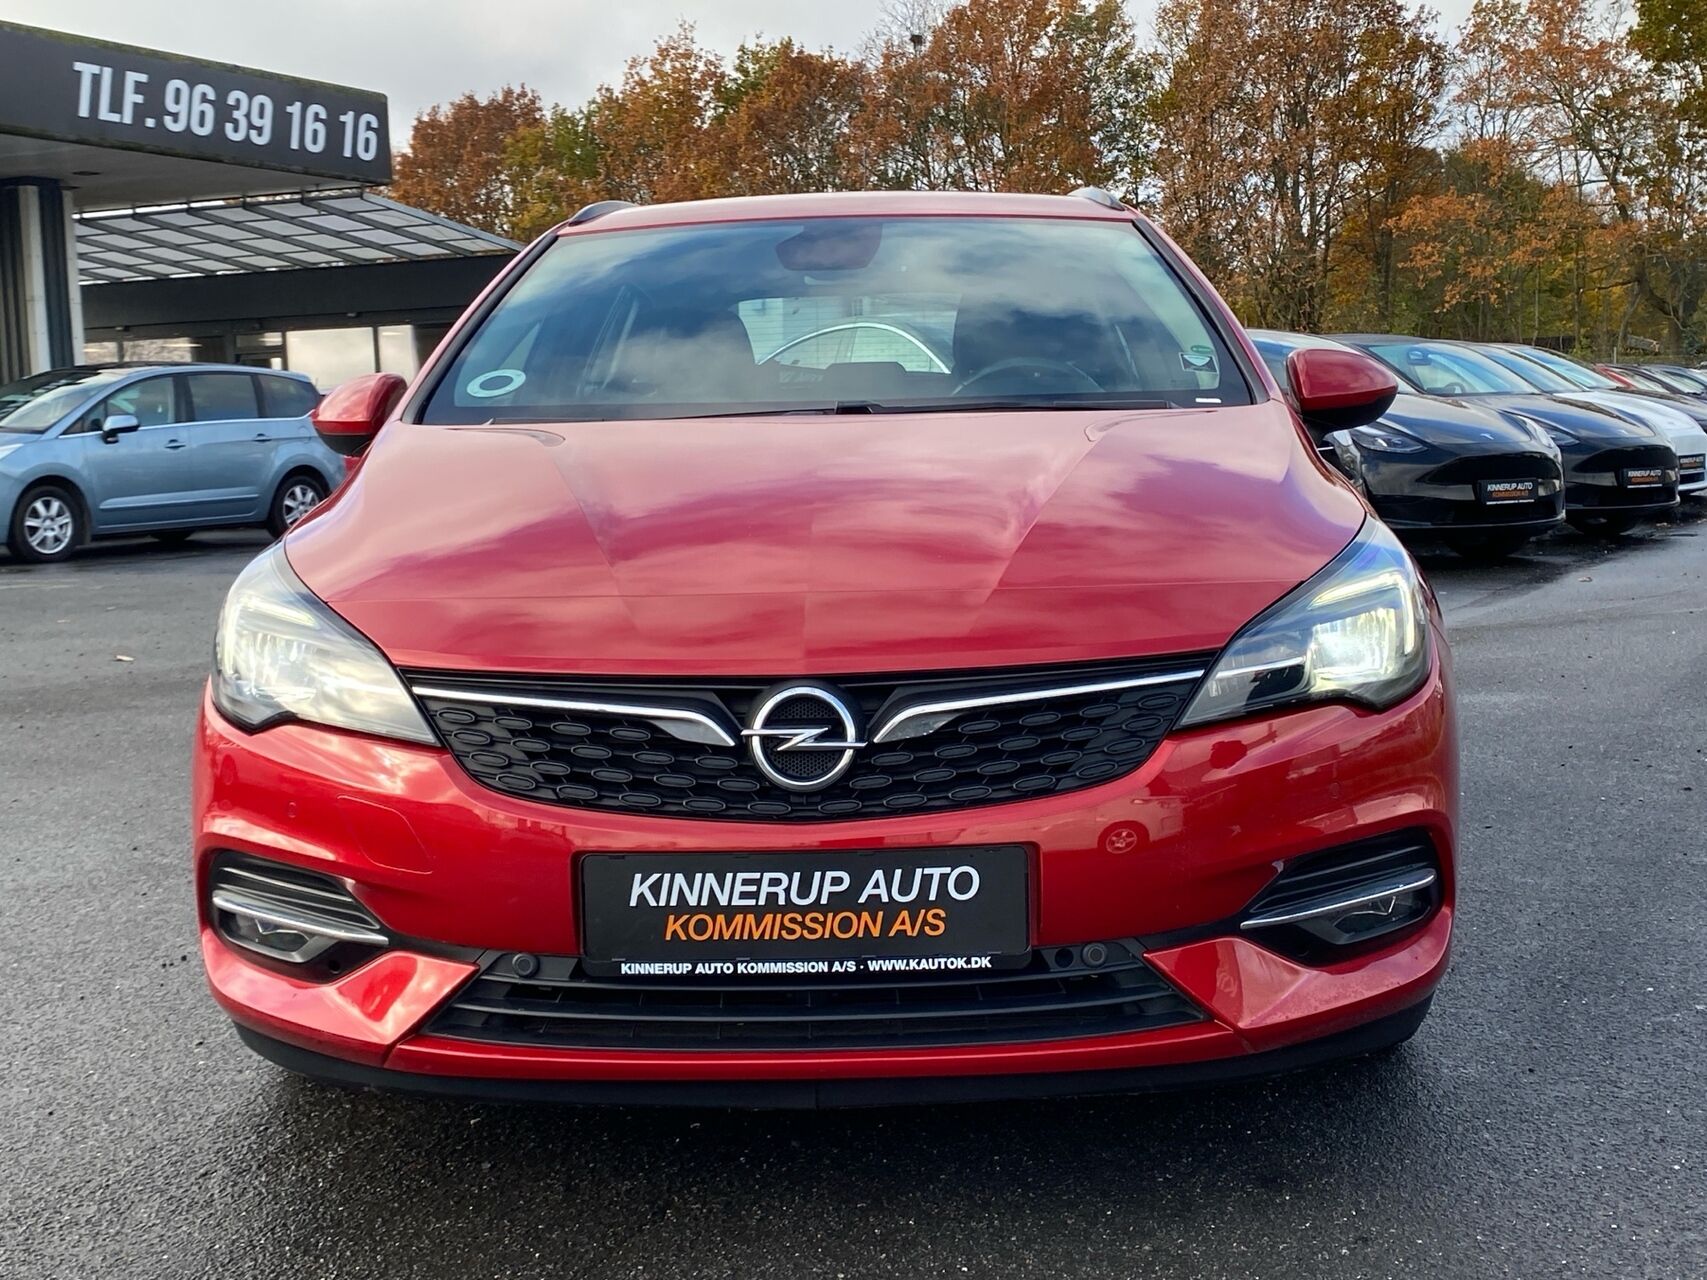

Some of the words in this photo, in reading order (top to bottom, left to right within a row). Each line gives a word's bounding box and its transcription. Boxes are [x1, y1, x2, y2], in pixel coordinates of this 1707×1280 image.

[72, 61, 156, 128] TLF.
[163, 79, 216, 136] 96
[224, 89, 273, 145] 39
[286, 101, 327, 153] 16
[339, 110, 379, 161] 16
[1487, 483, 1517, 491] KINNERUP
[1517, 481, 1533, 490] AUTO
[629, 871, 850, 907] KINNERUP
[857, 865, 980, 904] AUTO
[665, 911, 884, 941] KOMMISSION
[888, 908, 946, 937] A/S
[620, 962, 692, 975] KINNERUP
[695, 962, 734, 975] AUTO
[737, 961, 830, 974] KOMMISSION
[831, 960, 857, 973] A/S
[867, 956, 992, 972] WWW.KAUTOK.DK
